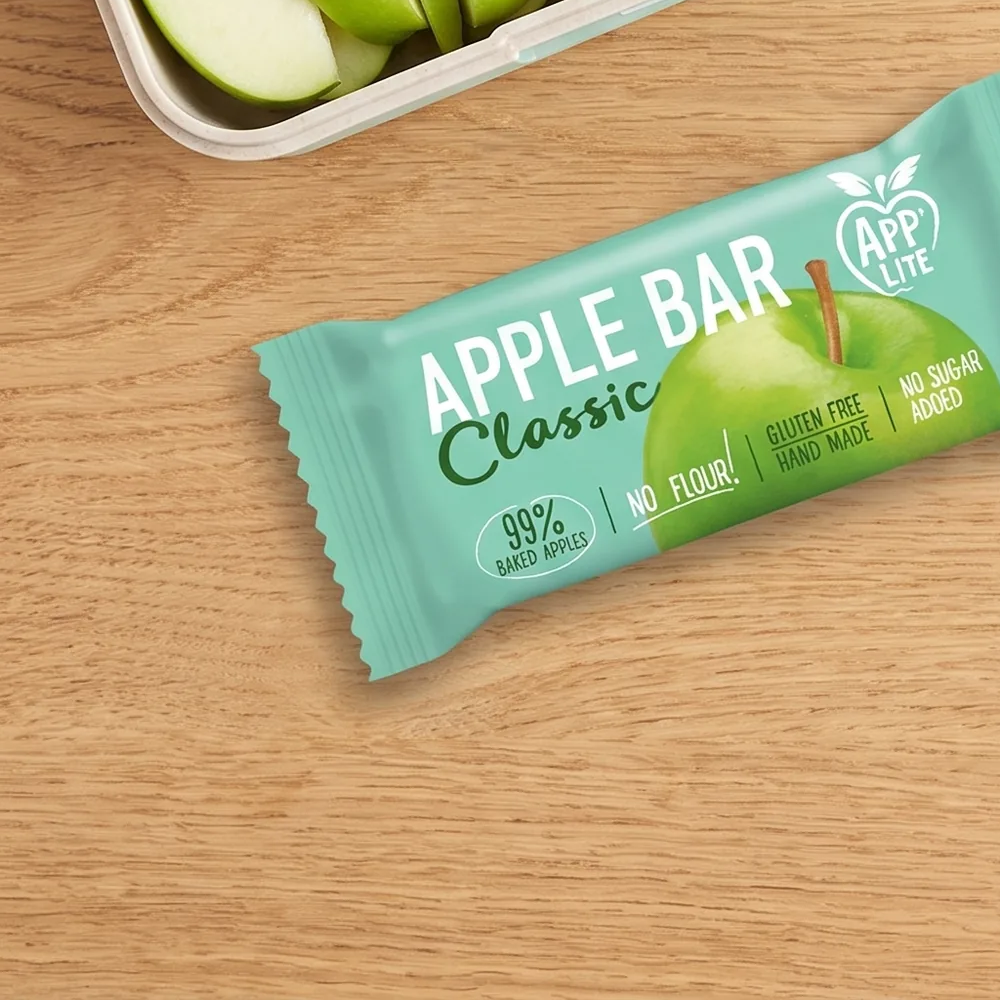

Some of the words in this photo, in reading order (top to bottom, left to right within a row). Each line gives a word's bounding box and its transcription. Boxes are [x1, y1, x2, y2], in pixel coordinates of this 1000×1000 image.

[878, 247, 934, 288] LITE
[421, 286, 638, 435] APPLE
[640, 234, 793, 350] BAR
[898, 370, 925, 399] NO
[926, 349, 984, 389] SUGAR
[438, 381, 661, 486] Classic
[765, 407, 823, 445] GLUTEN
[828, 392, 865, 424] FREE
[626, 483, 657, 518] NO
[668, 428, 740, 502] FLOUR!
[775, 440, 821, 473] HAND
[829, 421, 873, 453] MADE
[502, 498, 564, 550] 99%
[496, 549, 537, 577] BAKED
[544, 530, 588, 561] APPLES
